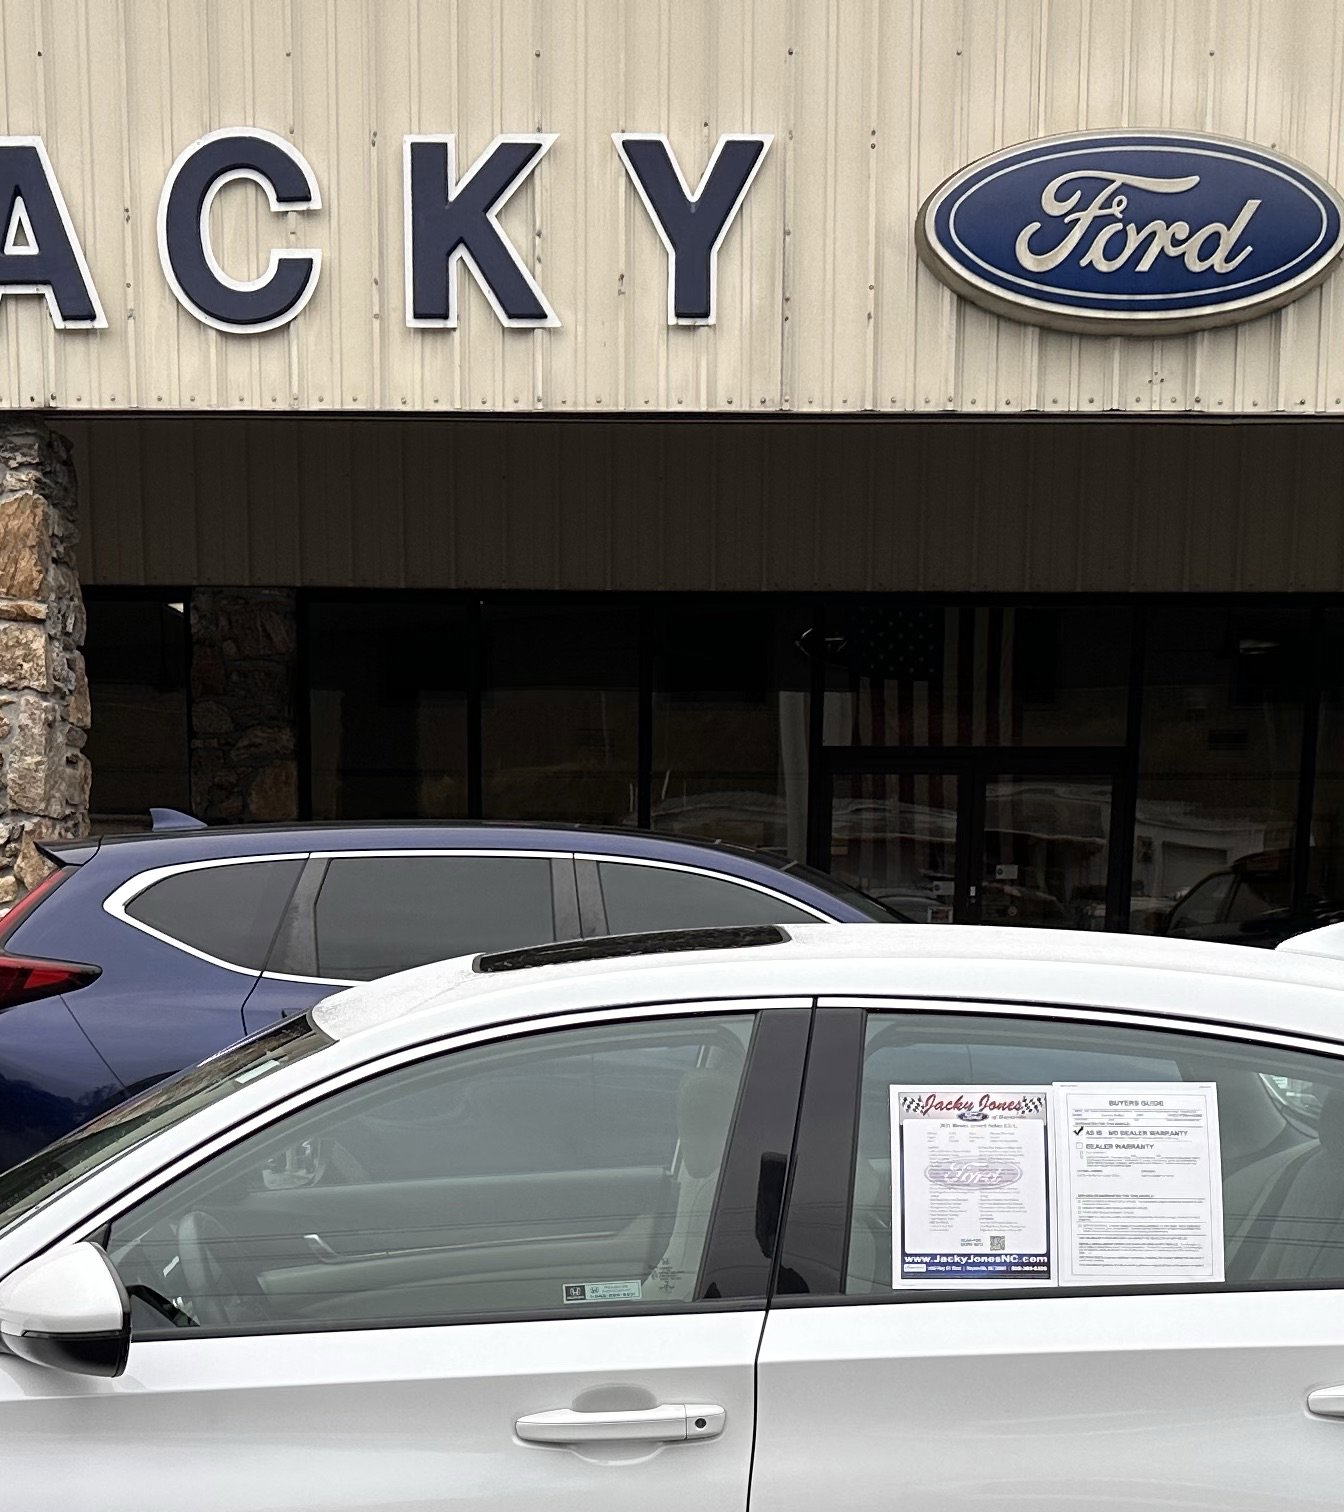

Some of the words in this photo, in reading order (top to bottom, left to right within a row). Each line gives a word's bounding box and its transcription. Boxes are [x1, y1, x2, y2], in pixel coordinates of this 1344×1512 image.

[1014, 169, 1263, 274] Ford
[922, 1093, 975, 1116] Jacky
[978, 1093, 1023, 1112] Jones
[904, 1254, 1048, 1264] www.JackyJonesNC.com
